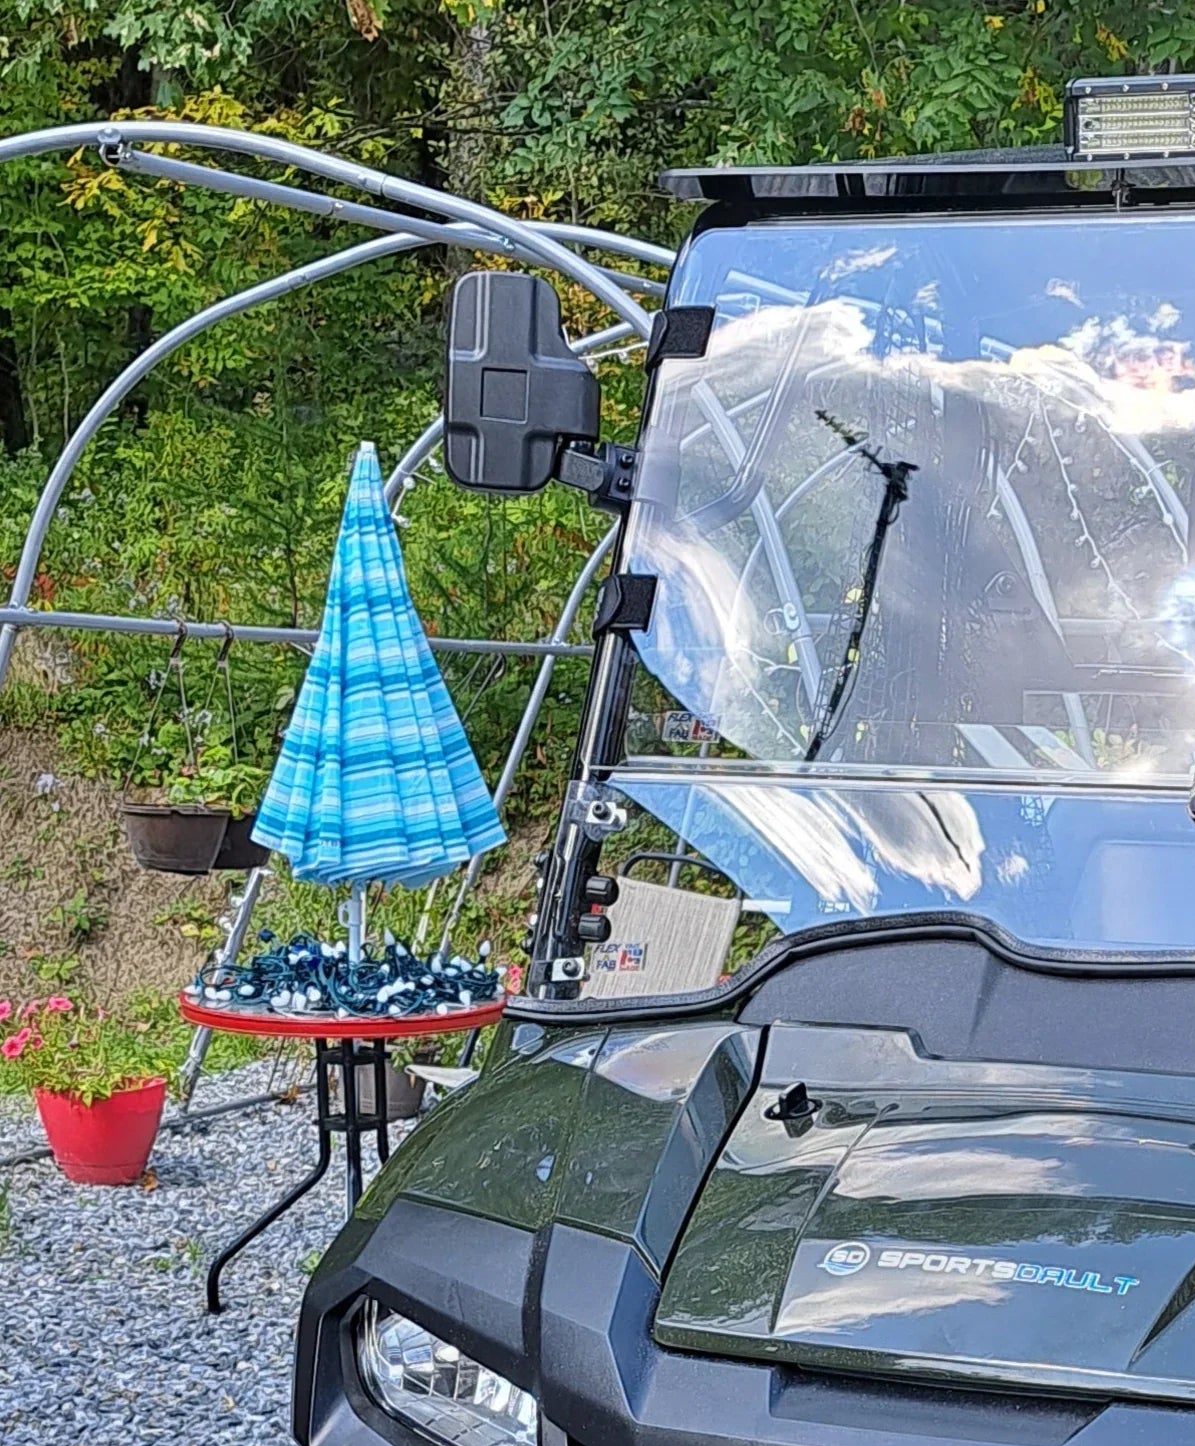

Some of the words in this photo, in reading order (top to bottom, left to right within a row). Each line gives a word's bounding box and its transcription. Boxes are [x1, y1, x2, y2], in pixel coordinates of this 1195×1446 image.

[594, 943, 622, 954] FLEX
[596, 960, 617, 971] FAB
[877, 1250, 1140, 1296] SPORTSDAULT
